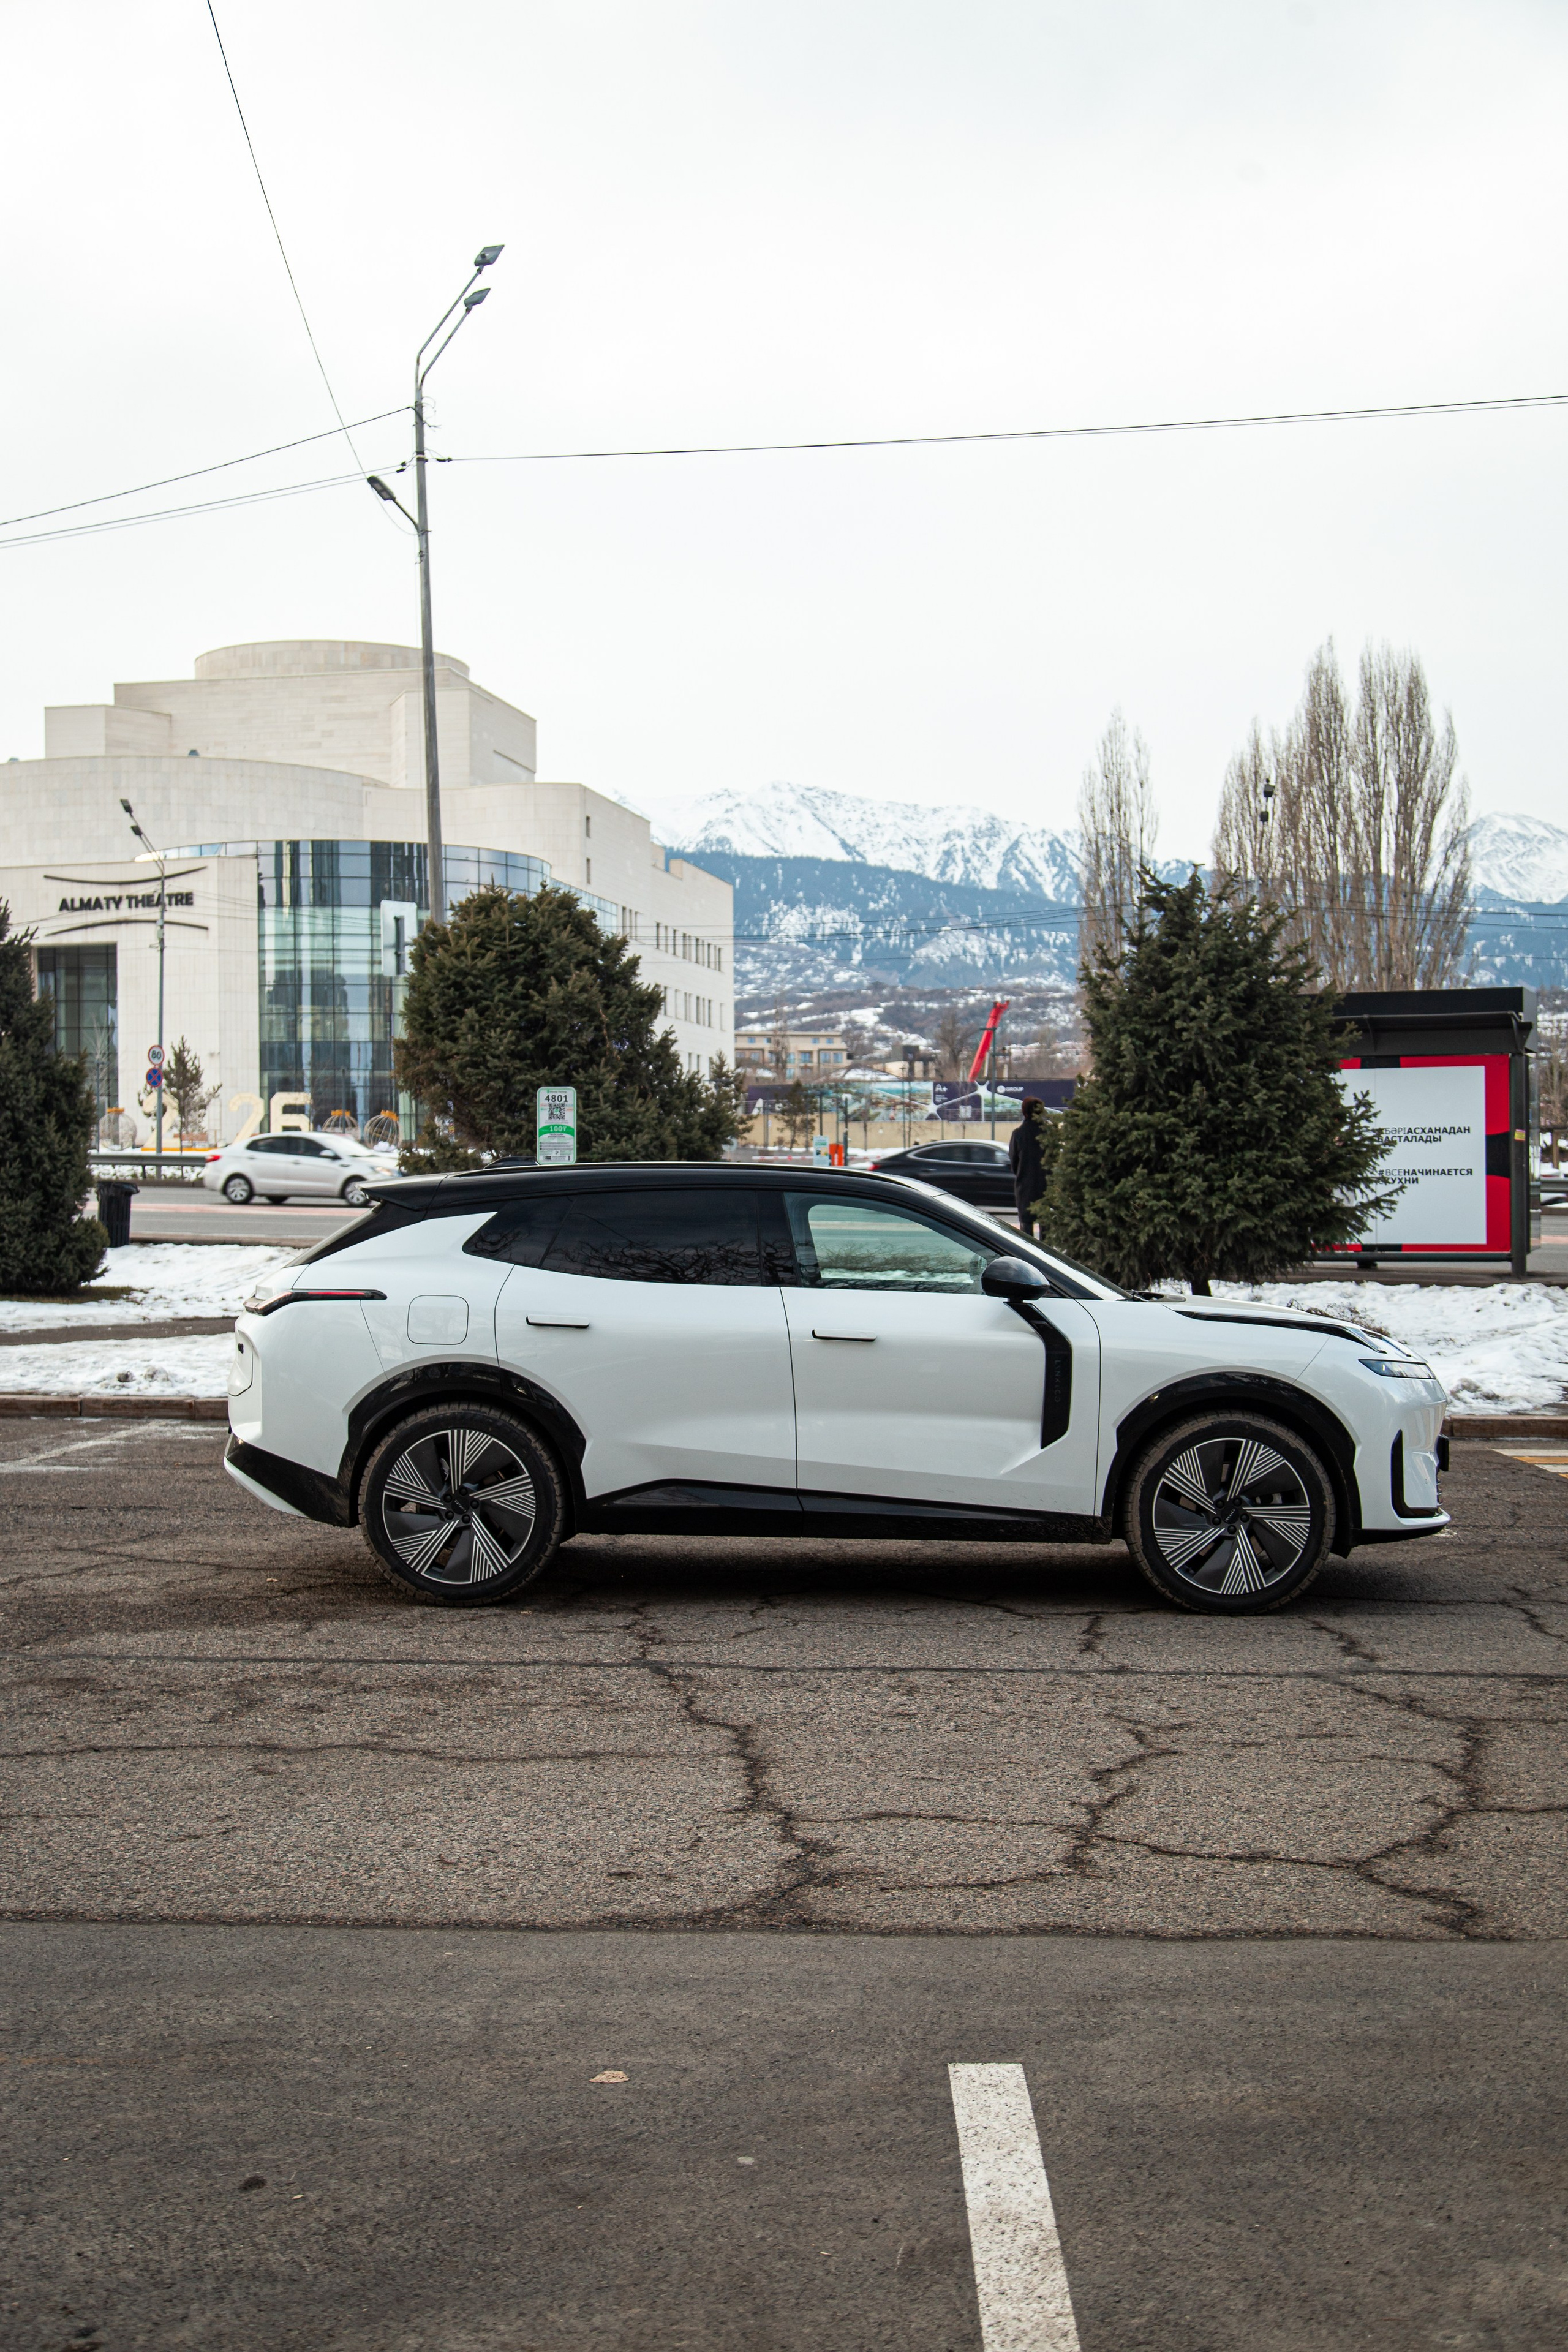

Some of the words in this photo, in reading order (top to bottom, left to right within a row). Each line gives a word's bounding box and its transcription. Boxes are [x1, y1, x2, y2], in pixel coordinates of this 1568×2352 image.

[59, 896, 123, 911] ALMATY
[126, 892, 194, 908] THEATRE
[151, 1050, 162, 1060] 80
[1378, 1126, 1471, 1136] БӘРІАСХАНАДАН
